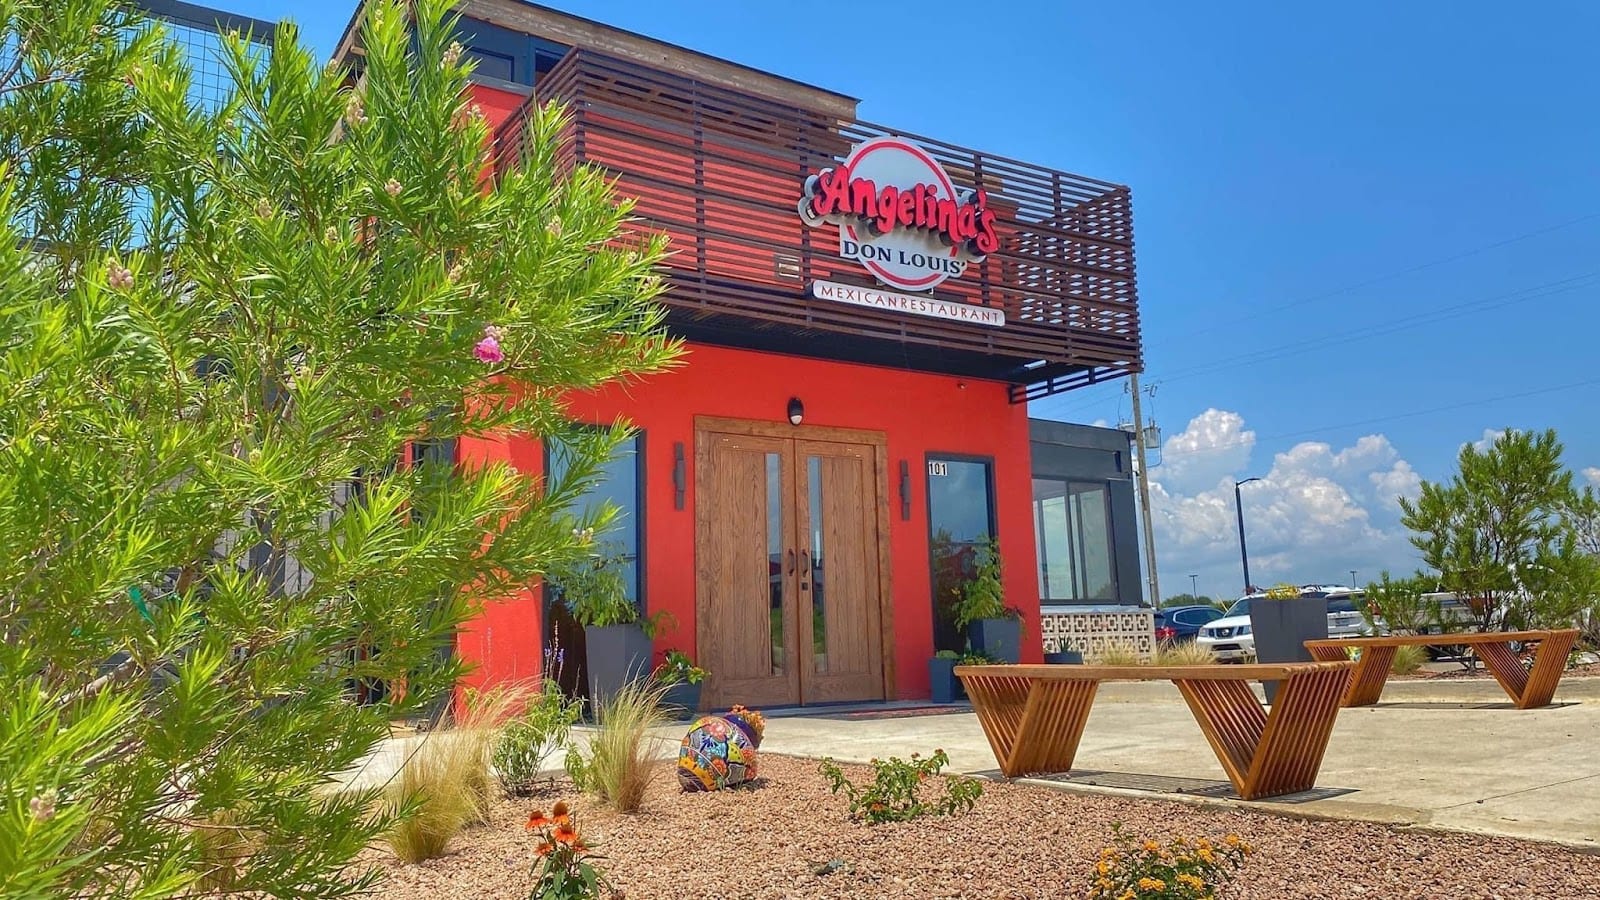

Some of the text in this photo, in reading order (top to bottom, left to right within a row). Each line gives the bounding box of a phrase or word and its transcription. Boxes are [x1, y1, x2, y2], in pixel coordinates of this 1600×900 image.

[812, 164, 999, 253] Angelina's
[843, 240, 891, 262] DON
[929, 463, 946, 475] 101
